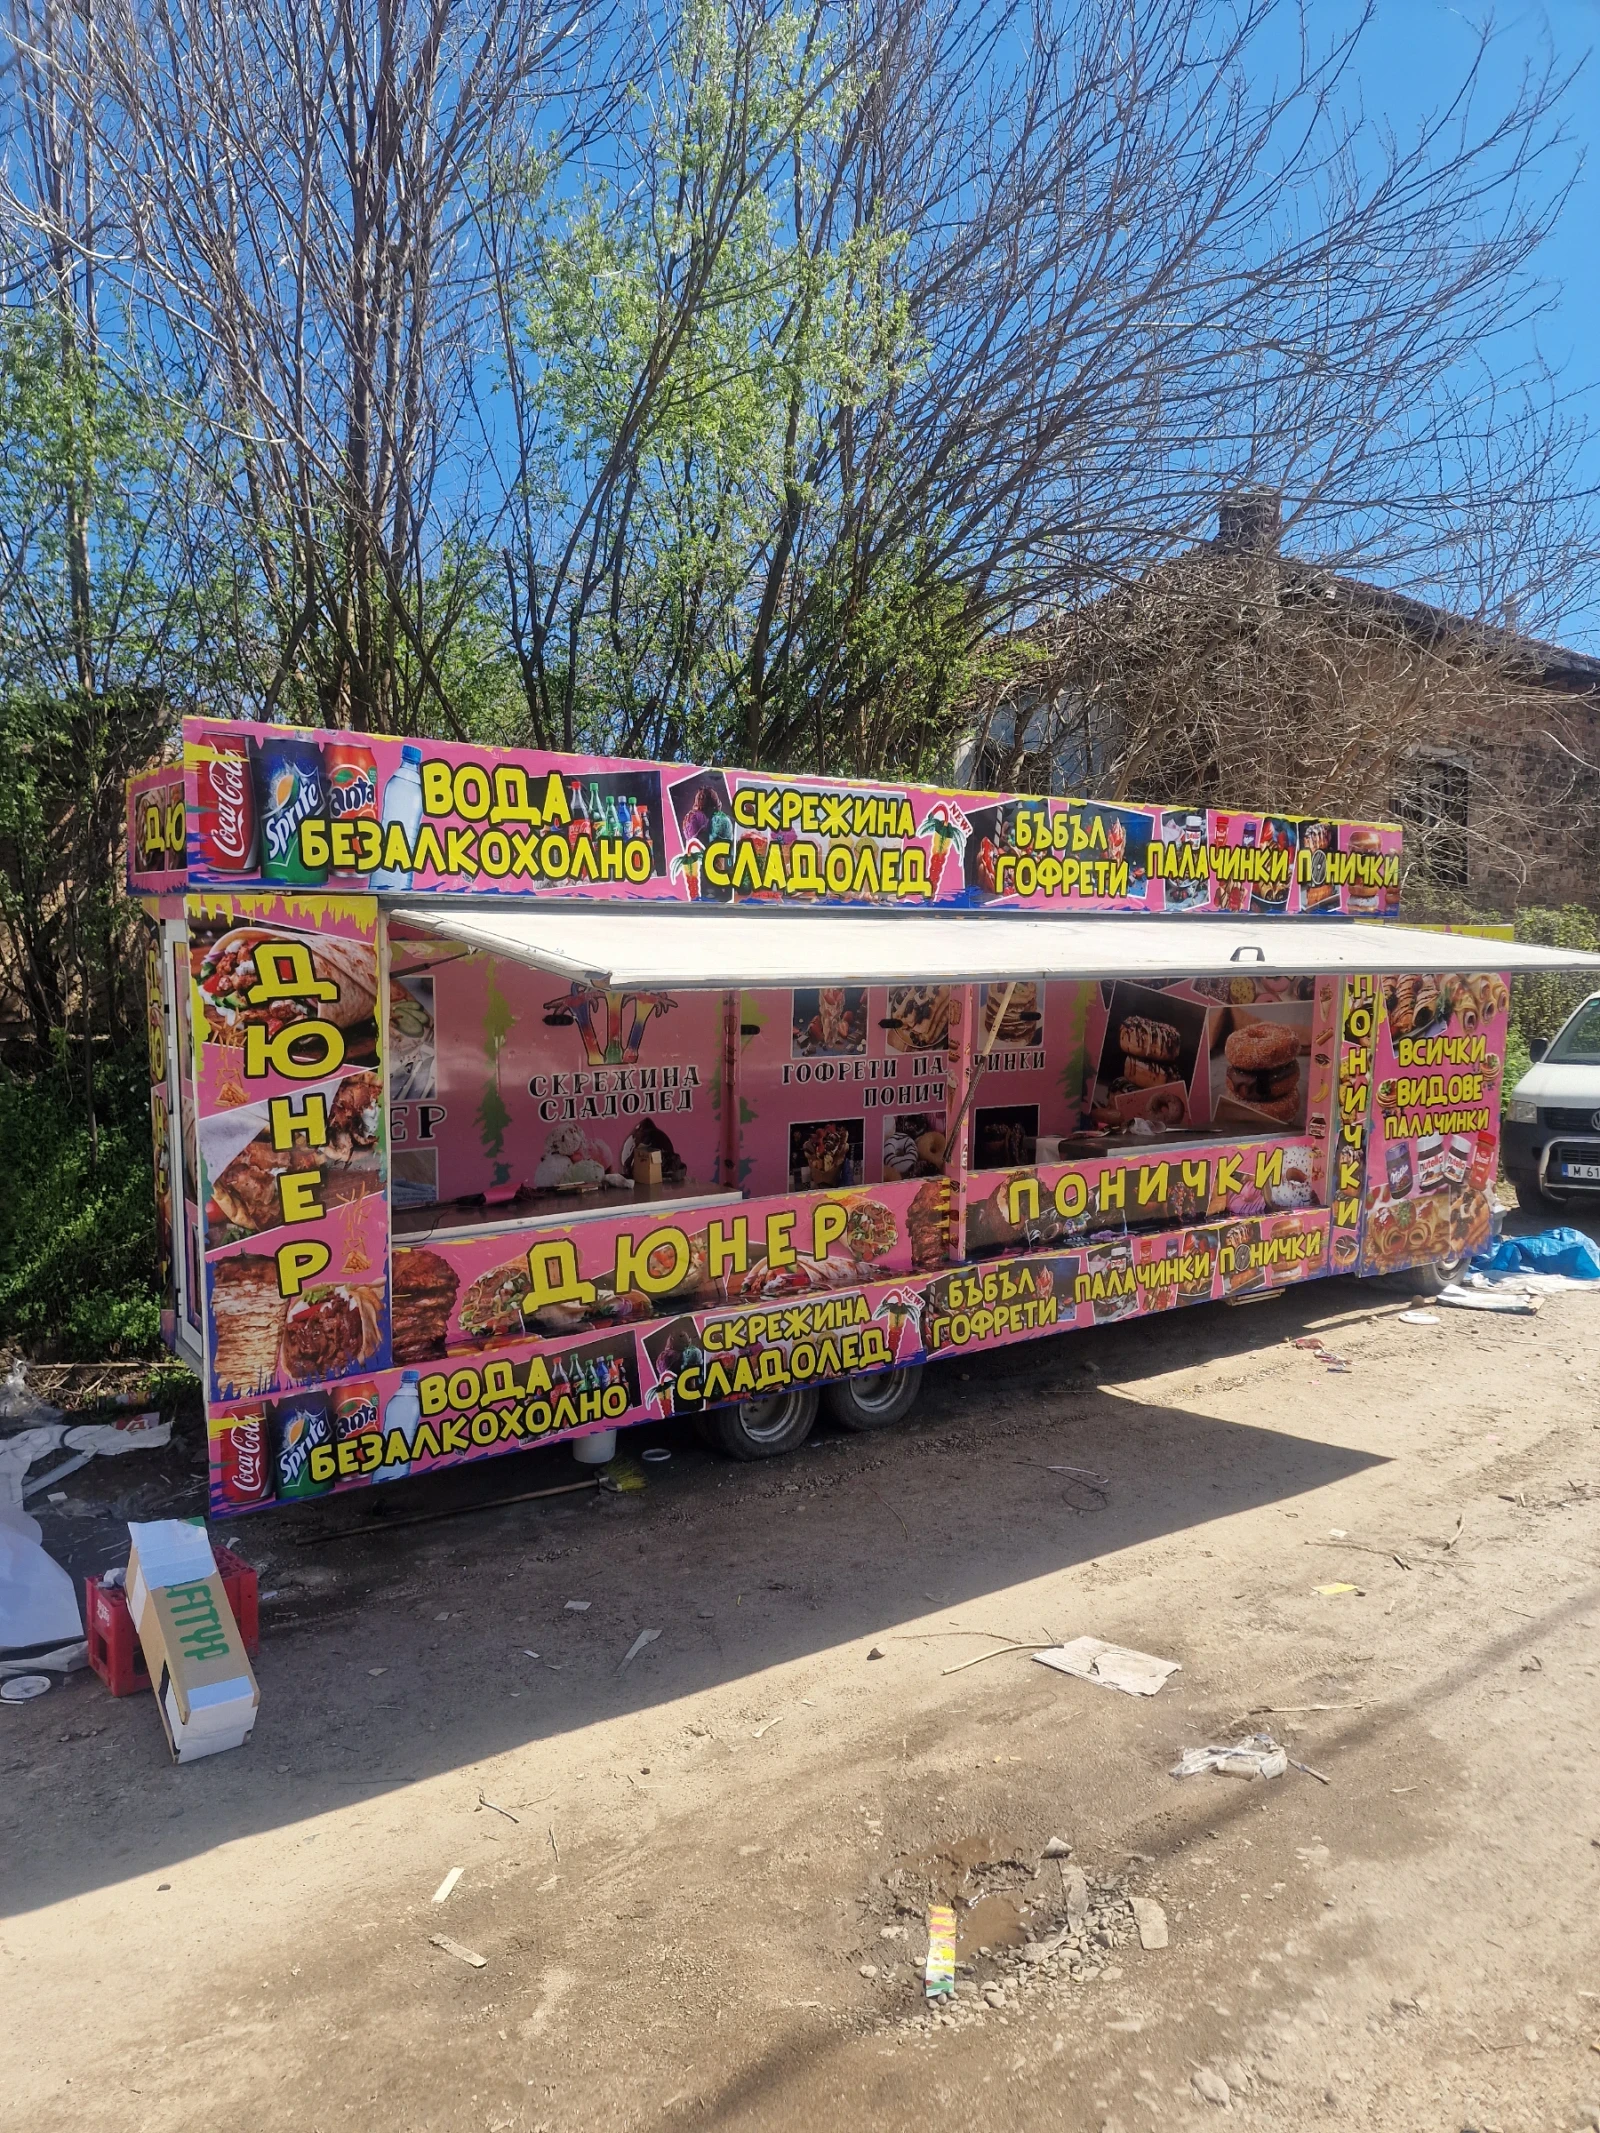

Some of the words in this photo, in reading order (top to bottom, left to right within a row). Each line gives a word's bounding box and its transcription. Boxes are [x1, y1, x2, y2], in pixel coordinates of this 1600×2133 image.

[331, 777, 375, 818] anta
[420, 760, 574, 827] ВОДА
[732, 787, 916, 838] СКРЕЖИНА
[950, 803, 972, 835] NEW!
[266, 785, 320, 861] Sprite
[1015, 809, 1108, 853] БЪБЪЛ
[299, 817, 652, 884] БЕЗАЛКОХОЛНО
[703, 841, 933, 897] СЛАДОЛЕД
[995, 852, 1129, 898] ГОФРЕТИ
[1146, 840, 1290, 884] ПАЛАЧИНКИ
[782, 1059, 897, 1085] ГОФРЕТИ
[912, 1051, 1045, 1076] ПАЧИНКИ
[1399, 1034, 1486, 1068] ВСИЧКИ
[529, 1066, 700, 1097] СКРЕЖИНА
[539, 1091, 693, 1121] СЛАДОЛЕД
[863, 1082, 945, 1107] ПОНИЧ
[1337, 975, 1373, 1228] ПОНИЧКИ
[1396, 1073, 1483, 1109] ВИДОВЕ
[243, 939, 346, 1299] ДЮНЕР
[1384, 1108, 1490, 1140] ПАЛАЧИНКИ
[1008, 1147, 1283, 1225] ПОНИЧКИ
[522, 1201, 849, 1314] ДЮНЕР
[1073, 1252, 1210, 1304] ПАЛАЧИНКИ
[947, 1266, 1036, 1311] БЪБЪЛ
[702, 1295, 870, 1351] СКРЕЖИНА
[932, 1297, 1058, 1348] ГОФРЕТИ
[417, 1355, 553, 1418] ВОДА
[675, 1328, 893, 1402] СЛАДОЛЕД
[308, 1384, 628, 1484] БЕЗАЛКОХОЛНО
[337, 1404, 377, 1439] anta
[279, 1418, 327, 1484] Sprite
